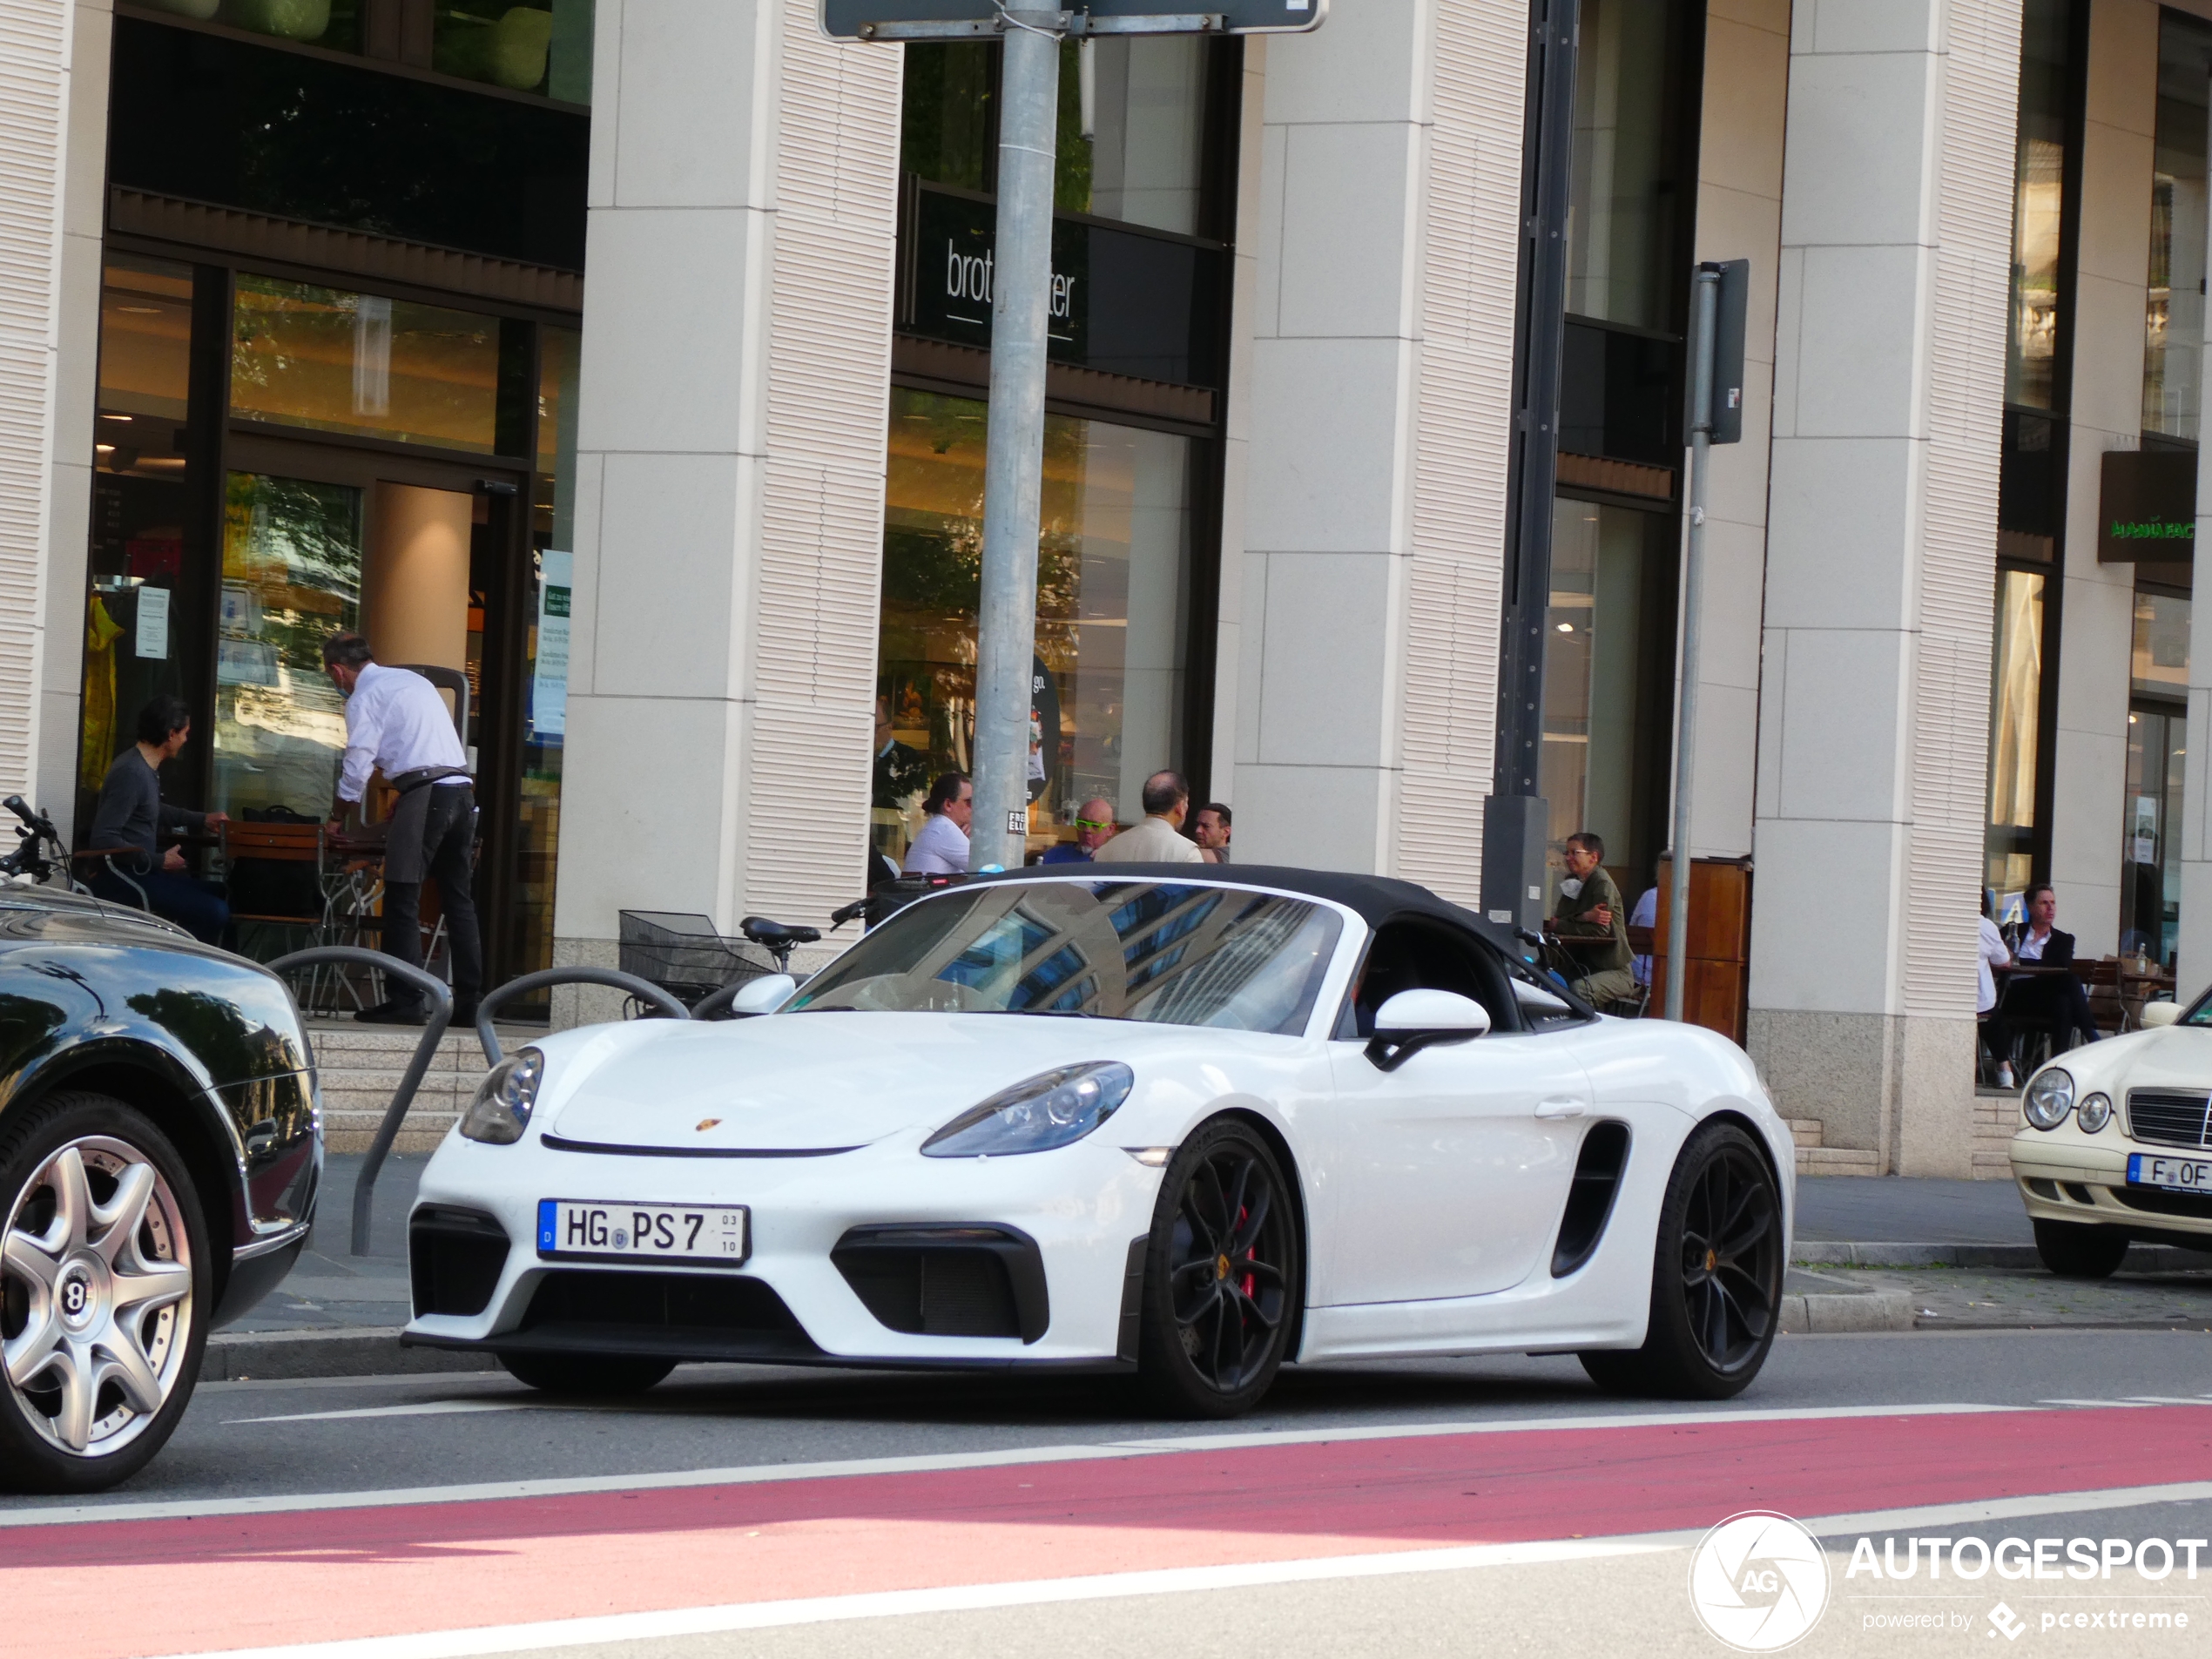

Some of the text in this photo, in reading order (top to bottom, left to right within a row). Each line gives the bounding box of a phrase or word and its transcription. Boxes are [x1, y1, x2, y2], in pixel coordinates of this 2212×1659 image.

[1008, 812, 1026, 823] FRE
[2152, 1160, 2209, 1185] F OF
[721, 1215, 737, 1225] 03
[568, 1209, 608, 1246] HG
[722, 1241, 736, 1252] 10
